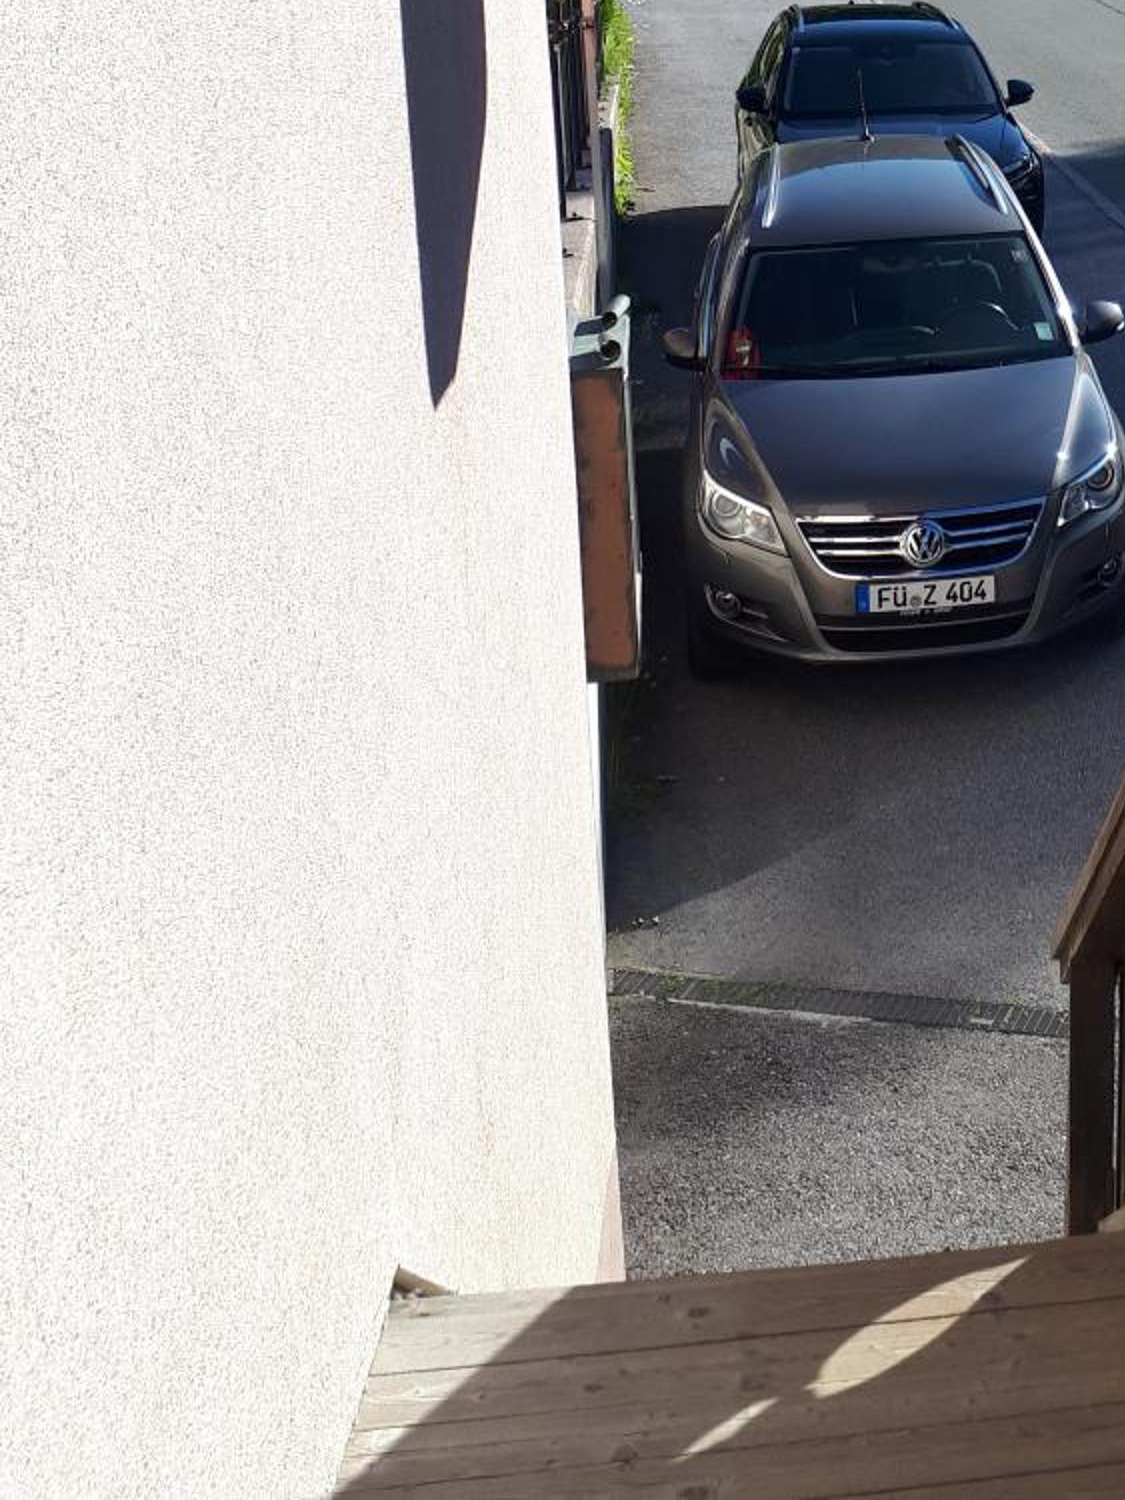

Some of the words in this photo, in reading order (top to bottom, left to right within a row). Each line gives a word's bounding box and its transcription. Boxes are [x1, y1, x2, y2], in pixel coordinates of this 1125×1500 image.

[877, 586, 907, 608] FÜ
[923, 583, 937, 606] Z
[945, 579, 987, 602] 404
